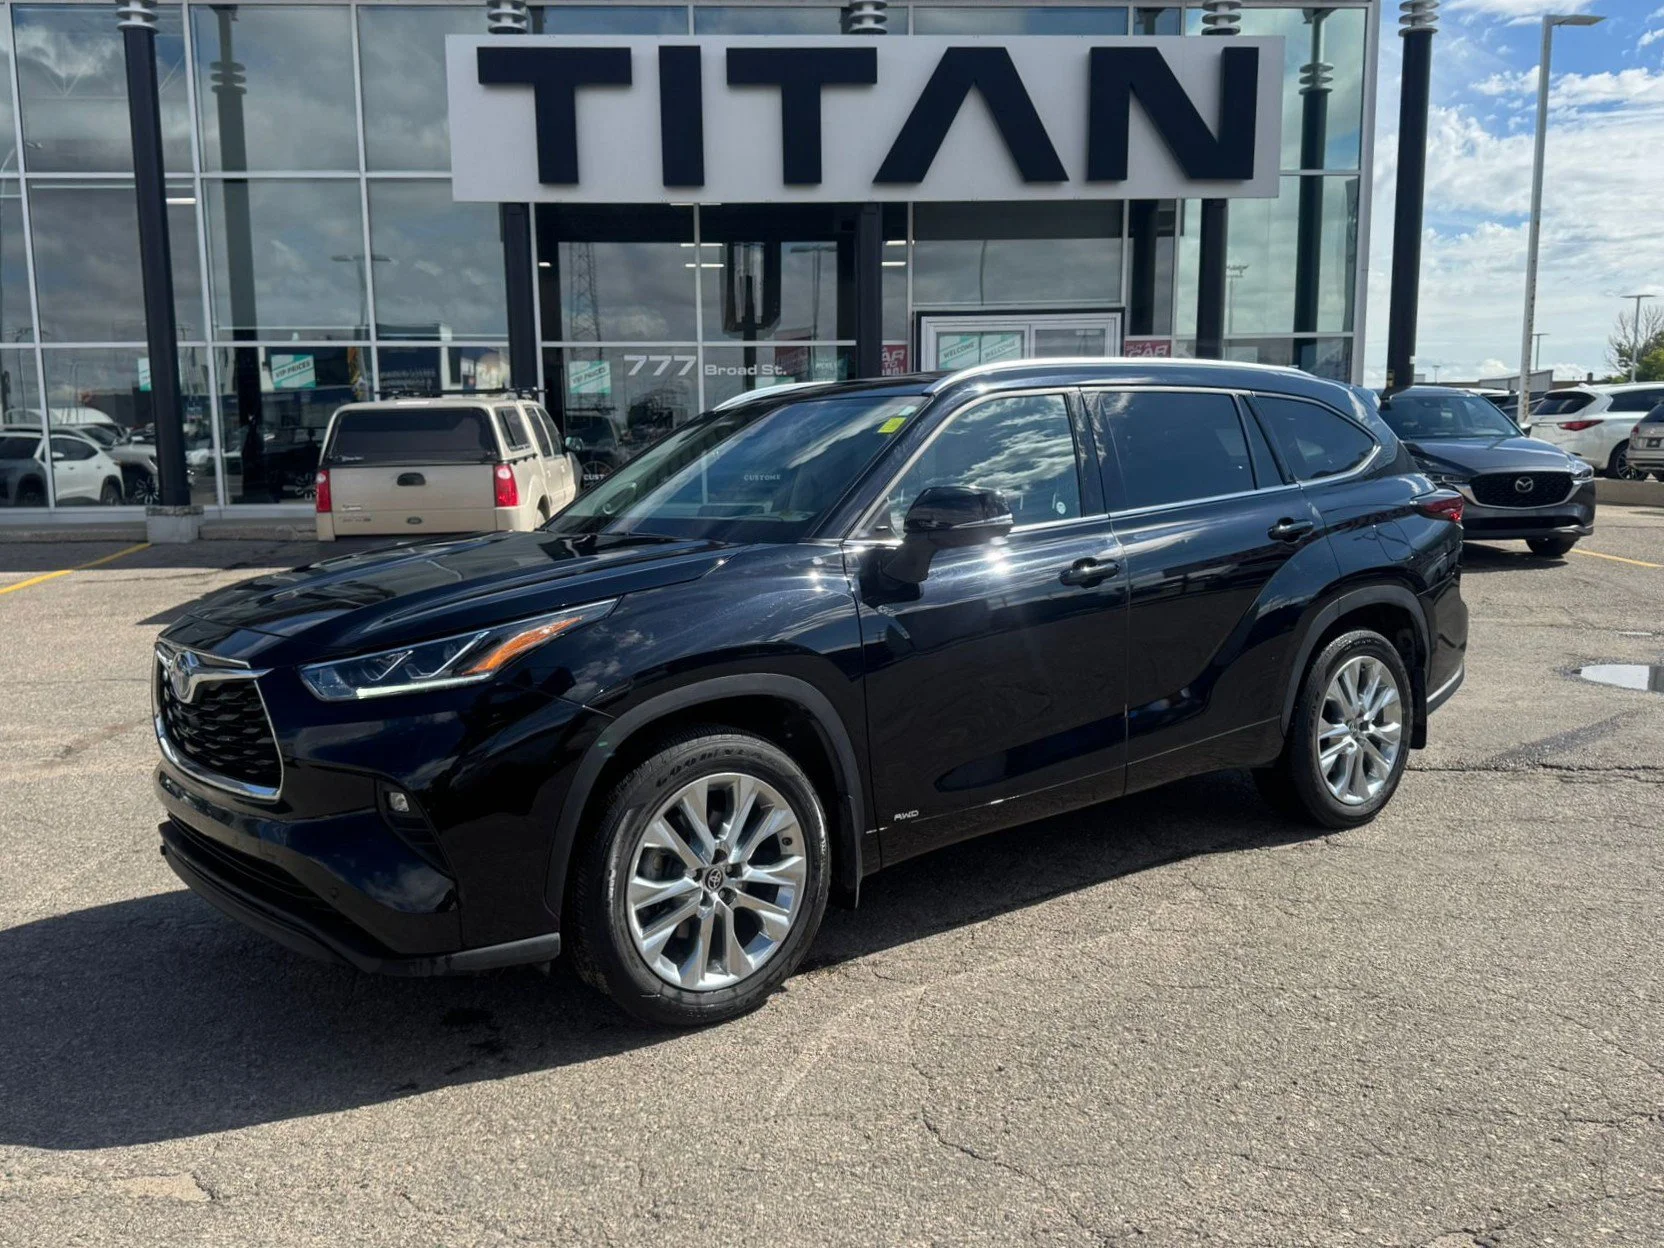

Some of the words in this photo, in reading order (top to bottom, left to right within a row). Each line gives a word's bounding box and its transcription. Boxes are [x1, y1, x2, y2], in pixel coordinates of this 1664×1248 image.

[476, 45, 1260, 187] TITAN
[881, 348, 906, 362] AR
[943, 341, 976, 359] WELCOME
[984, 340, 1017, 358] WELCOME
[623, 354, 697, 377] 777
[704, 364, 758, 376] Broad
[761, 364, 787, 377] St.
[893, 809, 919, 821] AWD
